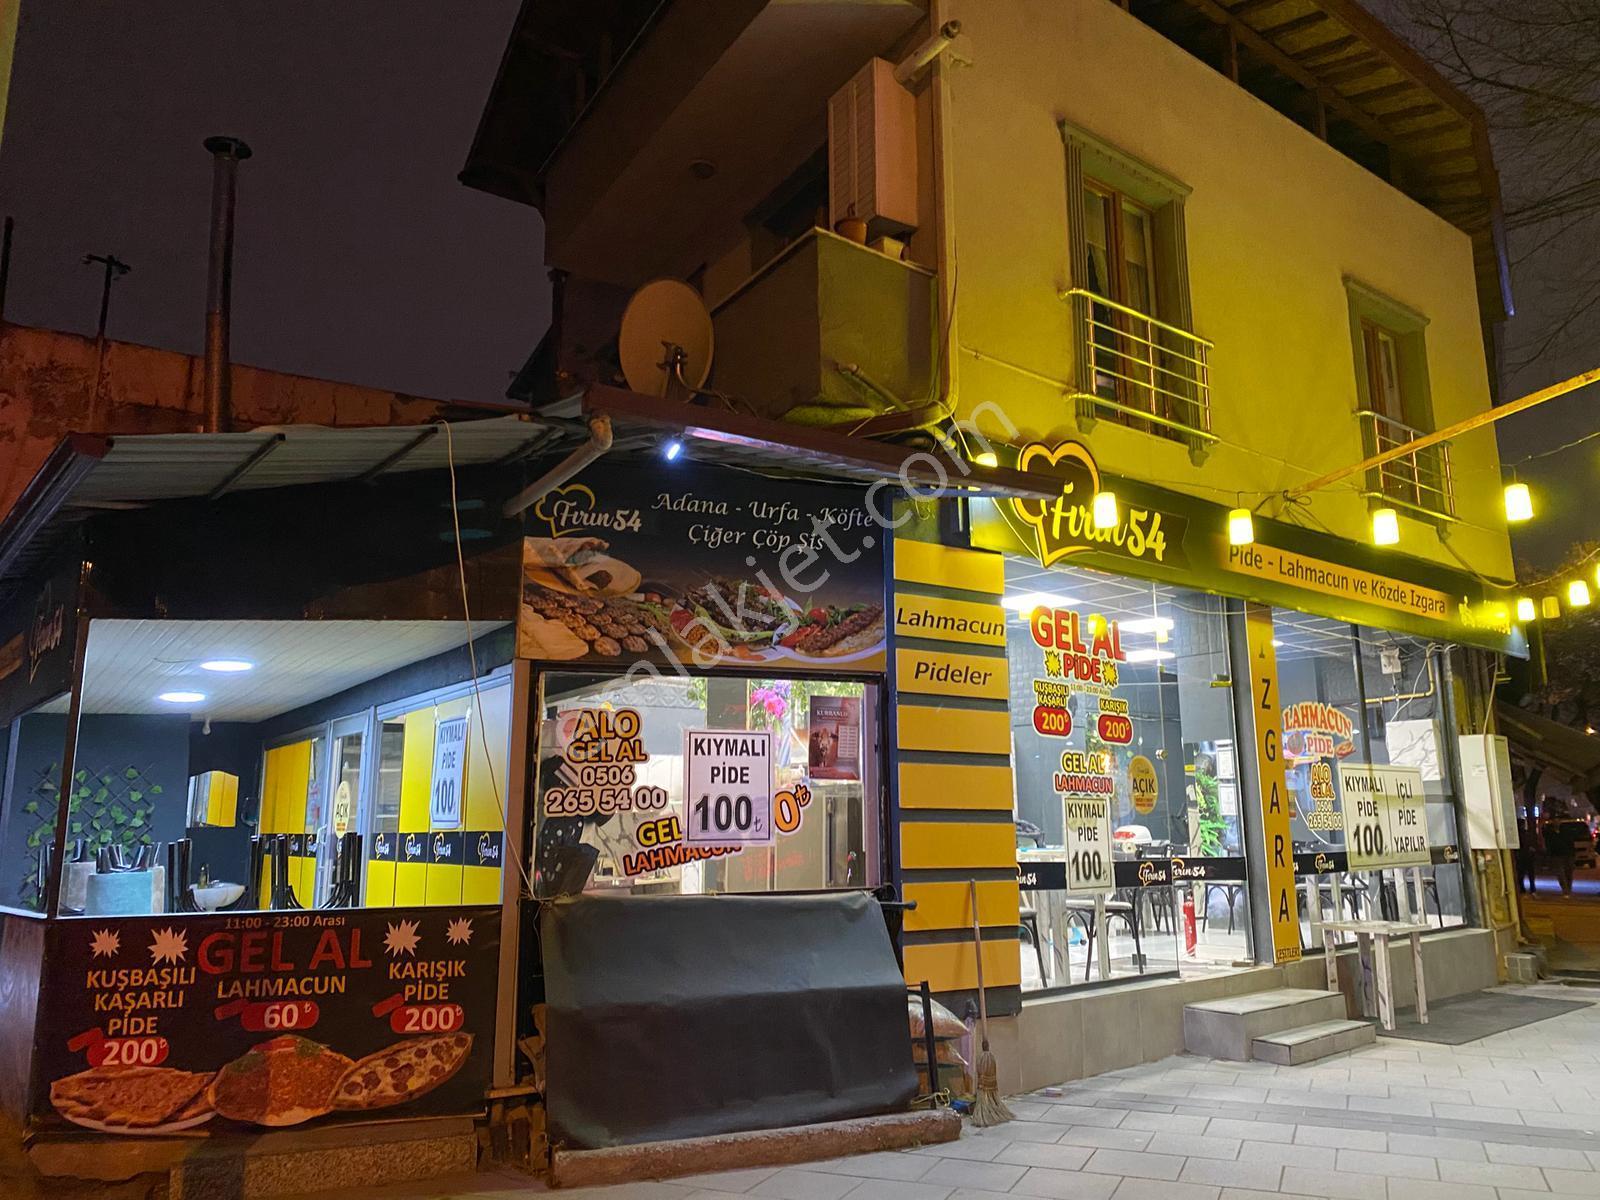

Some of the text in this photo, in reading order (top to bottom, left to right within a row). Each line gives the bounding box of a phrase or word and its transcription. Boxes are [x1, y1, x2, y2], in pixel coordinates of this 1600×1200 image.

[651, 493, 728, 515] Adana
[748, 502, 799, 525] Urfa
[818, 507, 873, 530] Köfte
[688, 524, 746, 549] Çiğer
[753, 529, 790, 552] Çöp
[1229, 545, 1263, 570] Pide
[1279, 556, 1348, 592] Lahmacun
[1352, 580, 1367, 594] ve
[1371, 579, 1407, 606] Közde
[1411, 590, 1446, 615] Izgara
[896, 608, 1005, 636] Lahmacun
[1031, 605, 1126, 661] GEL AL
[914, 662, 992, 686] Pideler
[574, 709, 640, 740] ALO
[1283, 703, 1352, 738] LAHMACUN
[567, 739, 648, 763] GEL AL
[694, 738, 766, 757] KIYMALI
[1306, 733, 1334, 754] PİDE
[711, 762, 750, 784] PİDE
[1062, 752, 1106, 774] GEL AL
[581, 765, 635, 787] 0506
[1055, 774, 1113, 793] LAHMACUN
[1345, 776, 1384, 793] KIYMALI
[1132, 778, 1156, 797] AÇIK
[547, 787, 668, 814] 265 54 00
[1068, 802, 1106, 819] KIYMALI
[1357, 797, 1379, 817] PİDE
[1398, 805, 1417, 826] PİDE
[1078, 824, 1098, 842] PİDE
[1394, 836, 1427, 853] YAPILIR
[225, 917, 262, 929] 11:00
[274, 916, 310, 928] 23:00
[313, 915, 345, 927] Arası
[198, 928, 373, 975] GEL AL
[86, 966, 196, 991] KUŞBAŞILI
[389, 960, 466, 982] KARIŞIK
[217, 975, 346, 999] LAHMACUN
[404, 980, 449, 1001] PİDE
[95, 990, 184, 1014] KAŞARLI
[108, 1013, 158, 1035] PİDE
